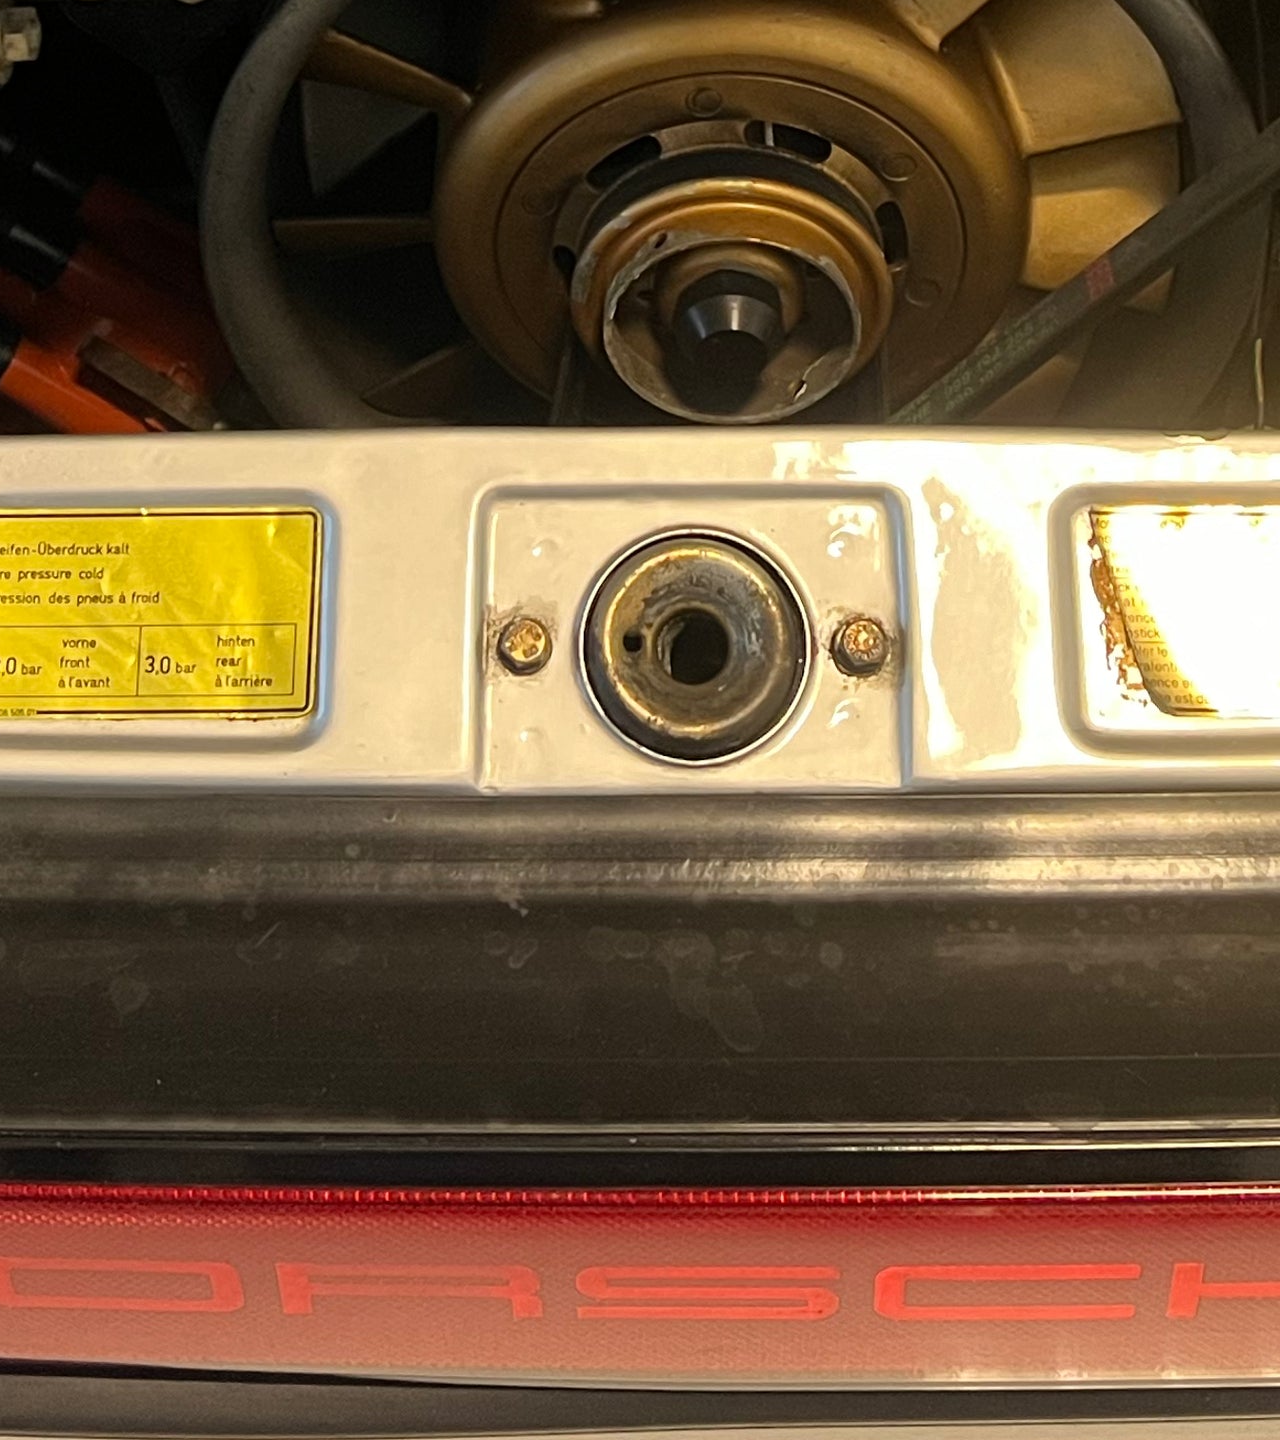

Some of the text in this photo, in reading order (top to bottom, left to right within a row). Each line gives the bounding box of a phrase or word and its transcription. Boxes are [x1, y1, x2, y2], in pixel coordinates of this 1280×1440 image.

[106, 543, 130, 555] kalt
[17, 569, 72, 582] pressure
[78, 567, 104, 580] cold
[48, 592, 71, 604] des
[76, 594, 114, 607] pneus
[118, 591, 126, 604] à
[131, 591, 160, 604] froid
[62, 639, 97, 648] vorne
[216, 635, 255, 647] hinten
[59, 656, 90, 668] front
[144, 655, 196, 675] 3,0 bar
[215, 656, 242, 667] rear
[21, 664, 42, 675] bar
